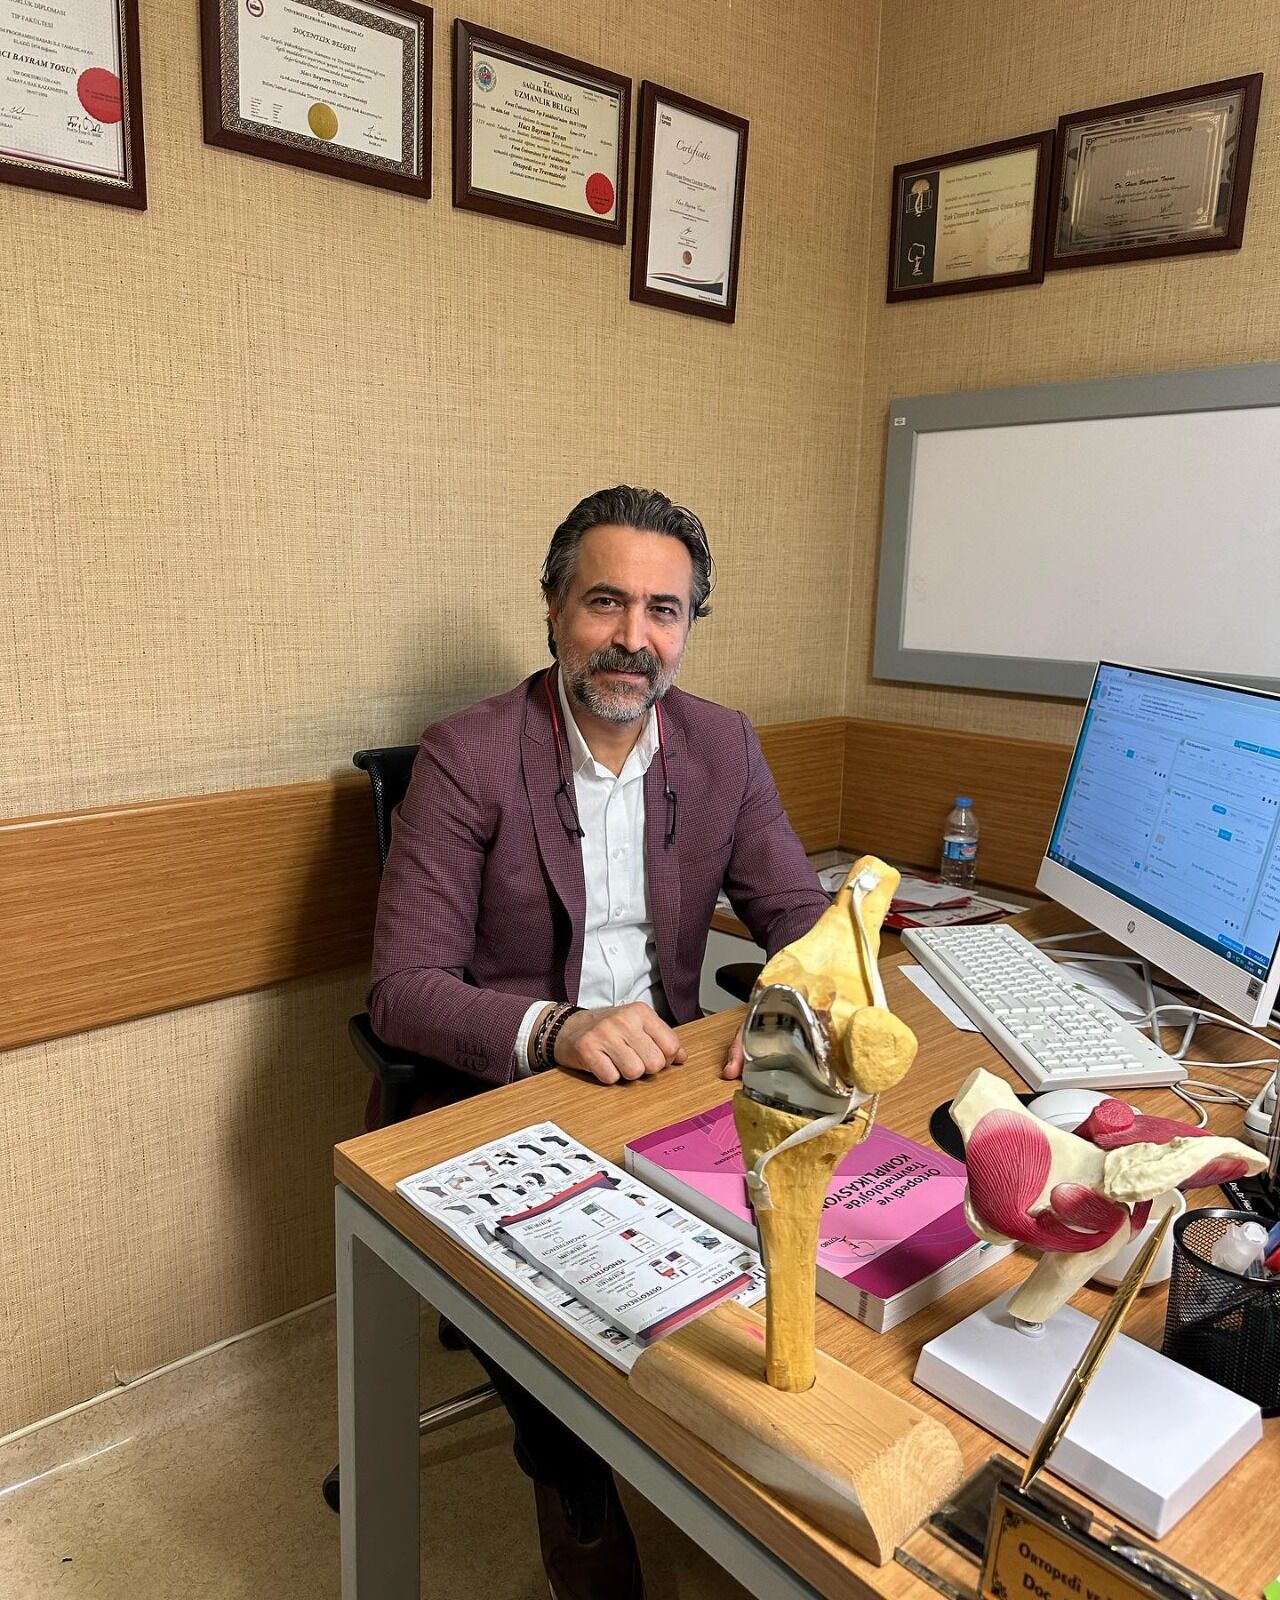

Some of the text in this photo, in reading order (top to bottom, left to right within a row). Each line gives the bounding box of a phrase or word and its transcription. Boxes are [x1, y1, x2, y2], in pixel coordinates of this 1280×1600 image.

[293, 27, 331, 45] DOÇENTLİK
[13, 53, 48, 68] BAYRAM
[50, 62, 78, 75] TOSUN
[514, 89, 580, 116] UZMANLIK BELGESİ
[531, 125, 551, 138] Bayram
[676, 139, 712, 165] Certificate
[843, 1161, 928, 1210] Travmatoloji'de
[876, 1168, 941, 1206] Ortopedi ve
[578, 1259, 626, 1285] TENDOTRENCH
[615, 1286, 662, 1312] OSTEOTRENCH
